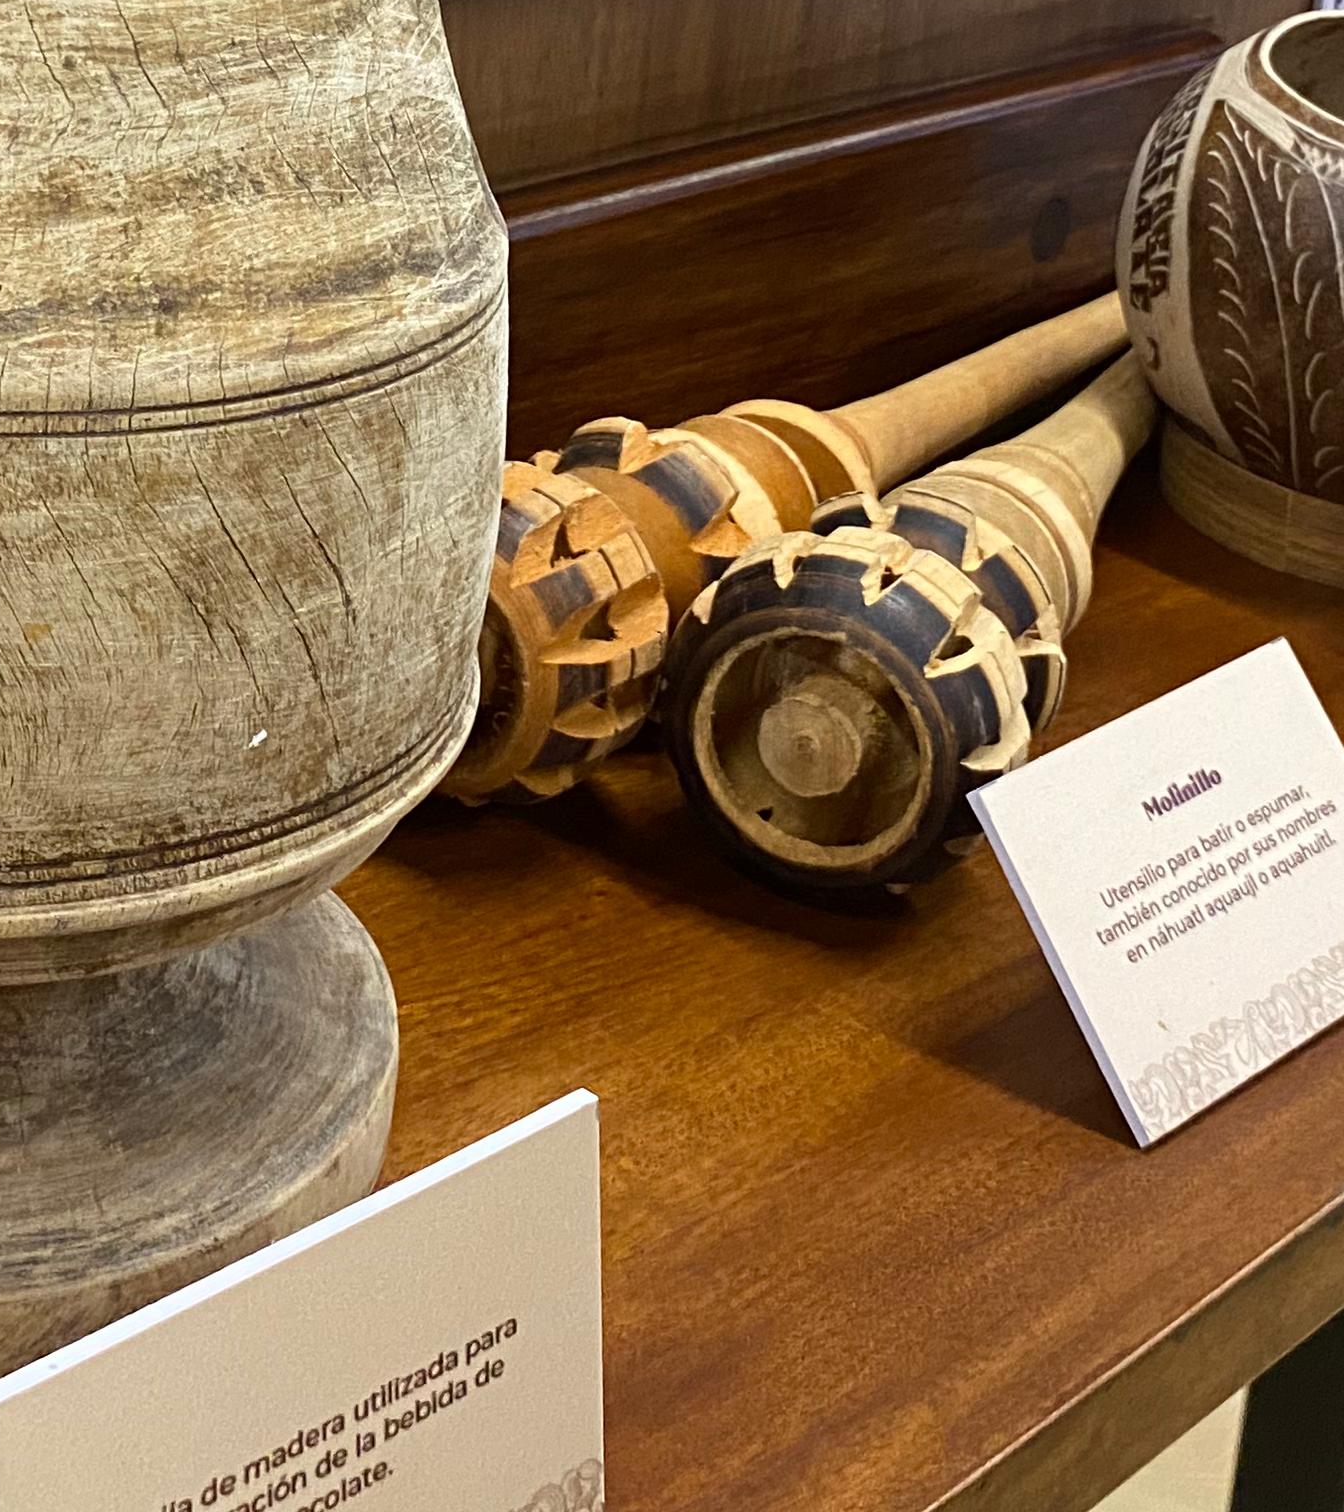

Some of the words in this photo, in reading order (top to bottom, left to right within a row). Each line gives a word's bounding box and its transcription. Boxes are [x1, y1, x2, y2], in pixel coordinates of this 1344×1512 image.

[1100, 864, 1165, 909] Utensilio
[1167, 846, 1200, 876] para
[1199, 824, 1233, 852] batir
[1236, 820, 1246, 832] o
[1247, 786, 1310, 826] espumar,
[1142, 769, 1221, 820] Molinillo
[1097, 902, 1161, 945] también
[1162, 864, 1226, 908] conocido
[1227, 847, 1253, 880] por
[1253, 834, 1277, 856] sus
[1277, 801, 1336, 842] nombres
[1127, 944, 1148, 963] en
[1149, 905, 1205, 950] náhuatl
[1259, 872, 1269, 885] o
[201, 1475, 236, 1506] de
[244, 1414, 347, 1484] madera
[354, 1352, 459, 1422] utilizada
[466, 1319, 517, 1365] para
[230, 1472, 306, 1512] ación
[315, 1449, 347, 1478] de
[356, 1433, 375, 1457] la
[385, 1380, 467, 1440] bebida
[475, 1360, 504, 1387] de
[297, 1462, 394, 1512] colate.
